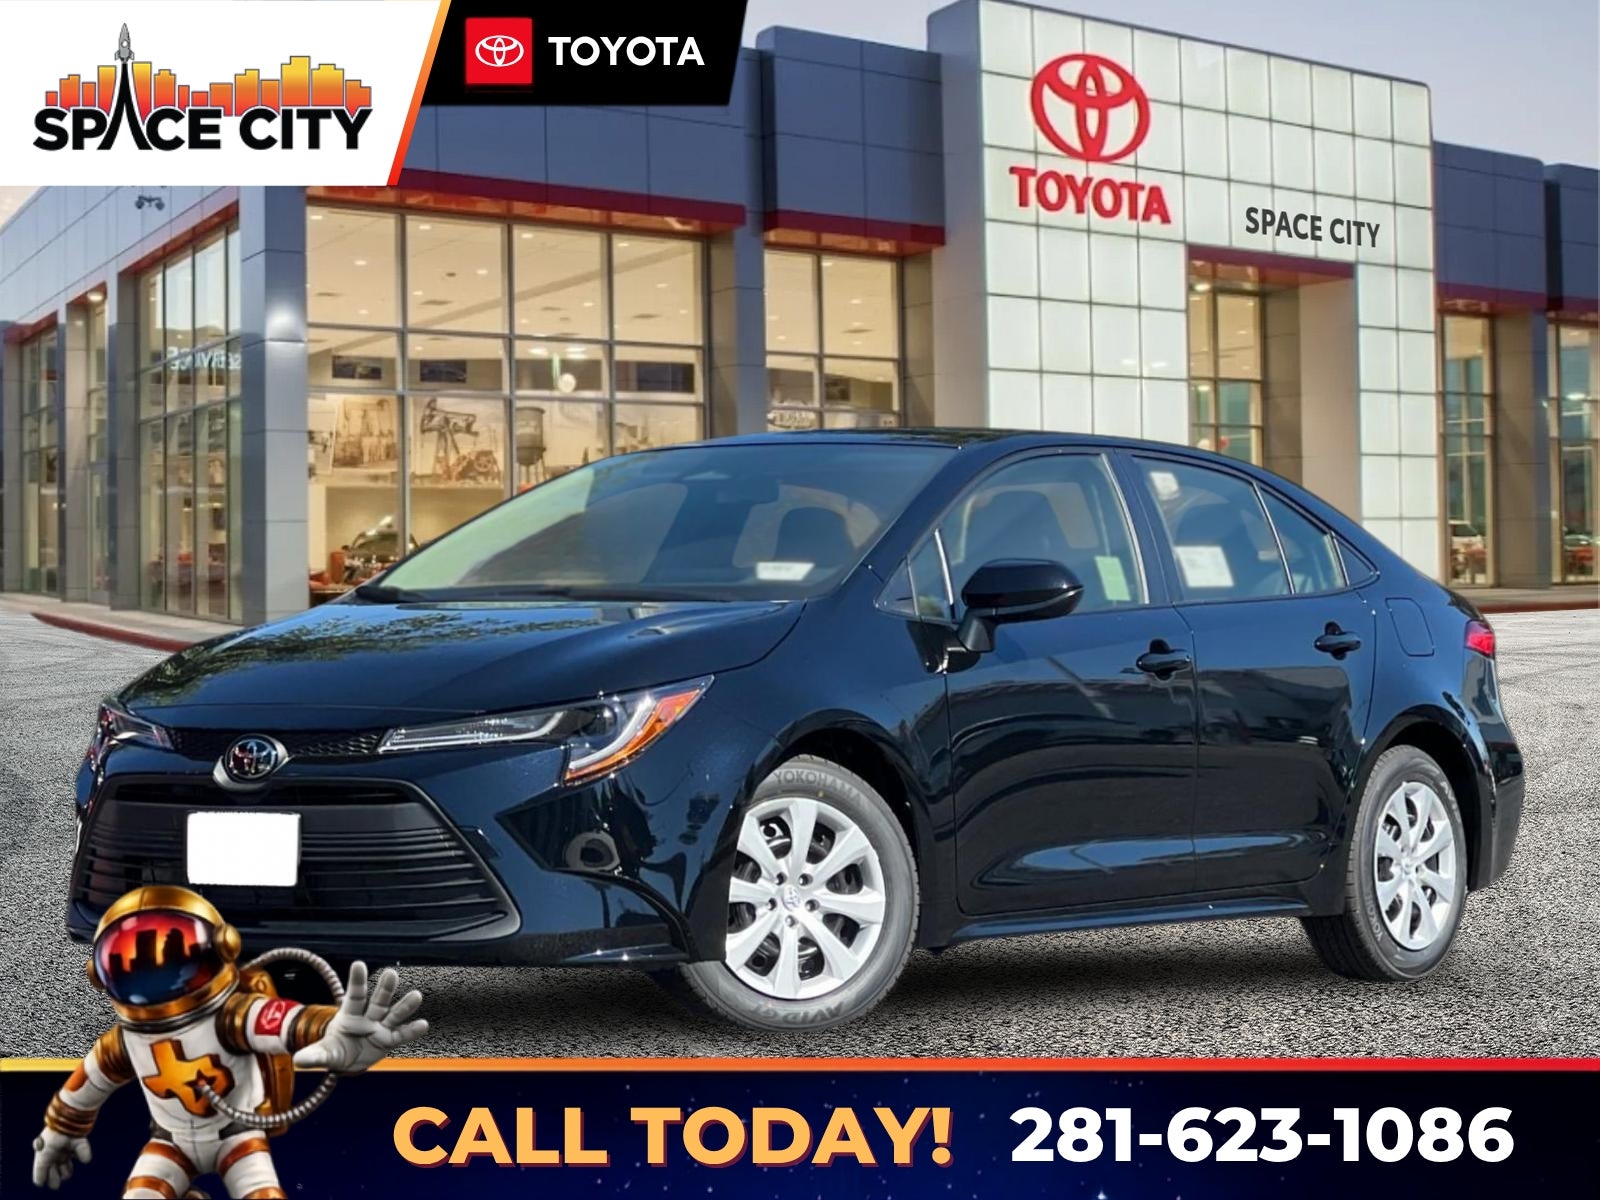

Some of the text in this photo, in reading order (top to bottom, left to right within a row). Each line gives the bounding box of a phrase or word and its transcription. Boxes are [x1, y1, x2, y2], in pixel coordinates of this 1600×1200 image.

[1009, 166, 1172, 225] TOYOTA
[1245, 206, 1381, 248] SPACE CITY
